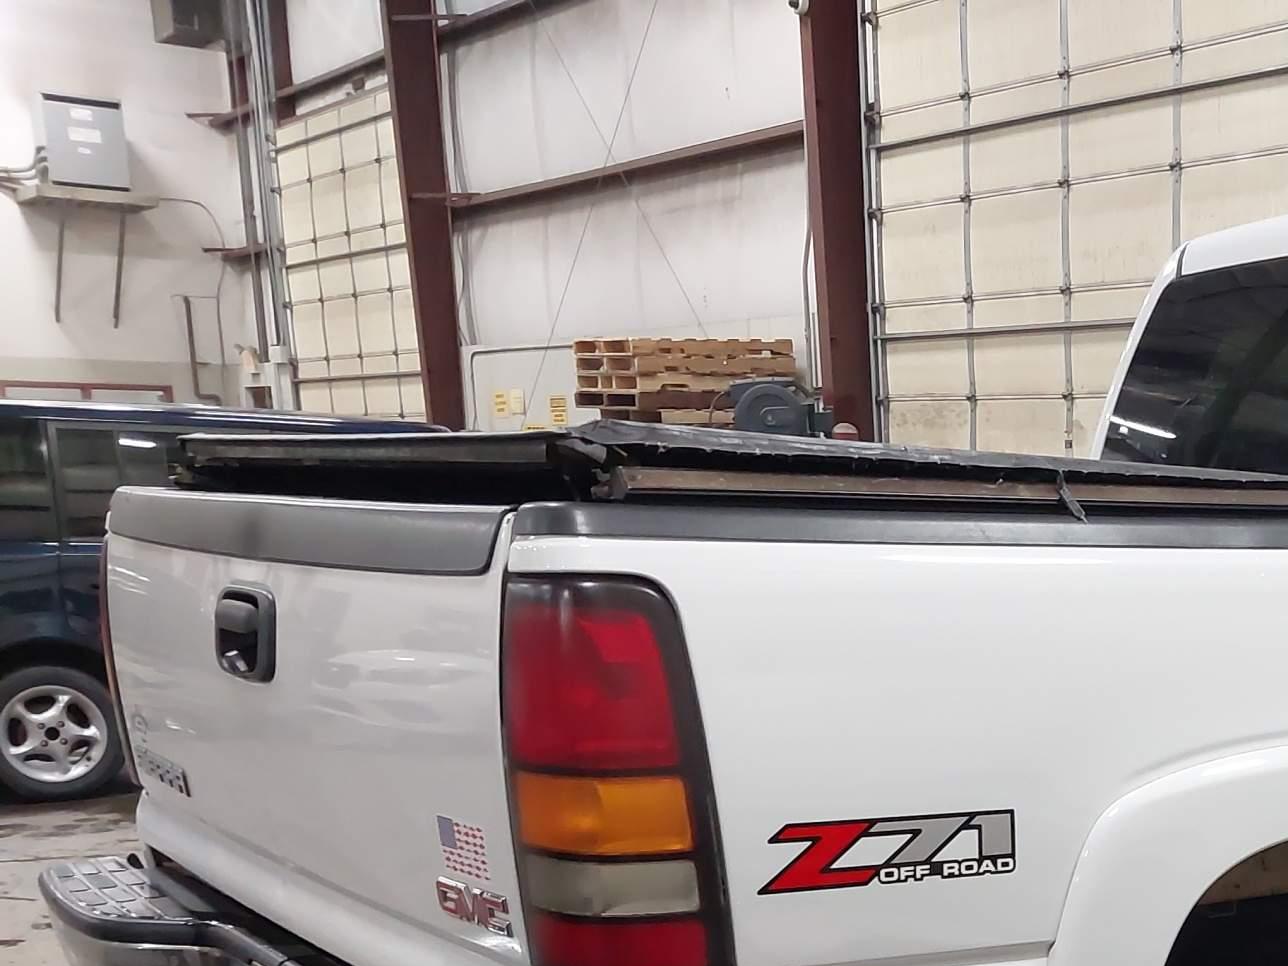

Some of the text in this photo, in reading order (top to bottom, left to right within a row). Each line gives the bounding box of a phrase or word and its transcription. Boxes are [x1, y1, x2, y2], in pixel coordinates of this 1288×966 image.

[757, 809, 1015, 895] Z71
[879, 857, 1015, 883] OFF ROAD
[436, 876, 514, 938] GMC
